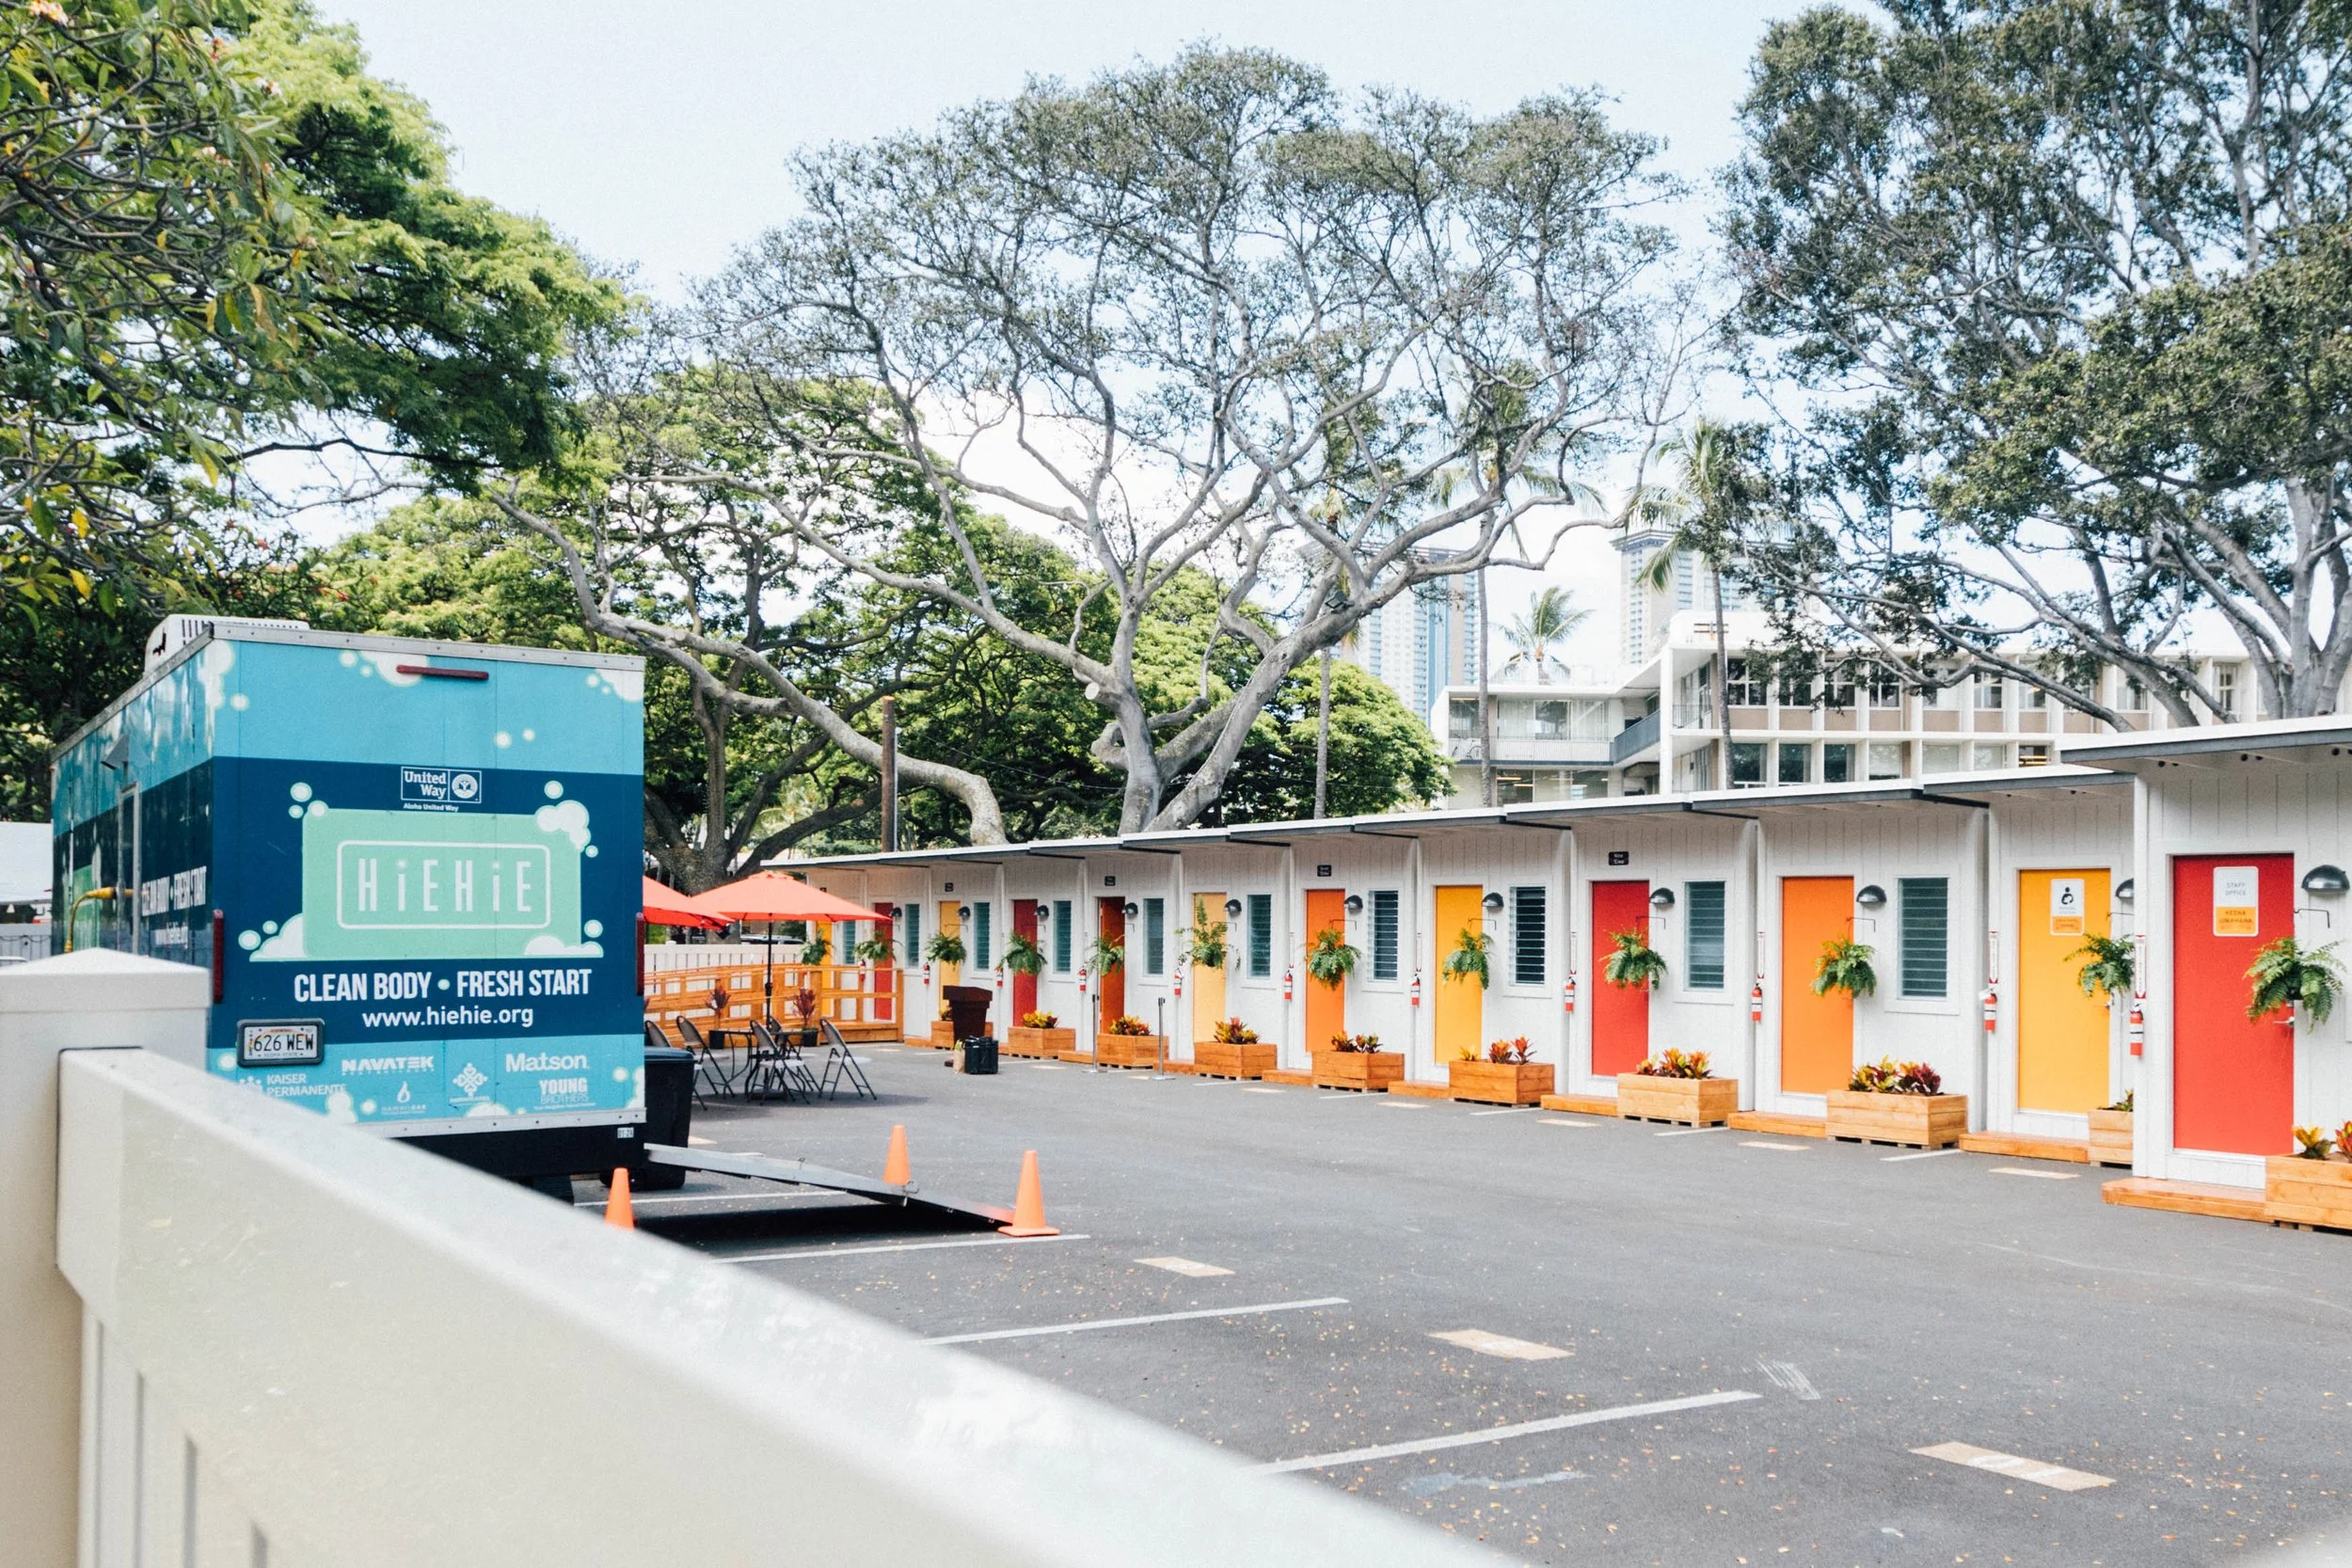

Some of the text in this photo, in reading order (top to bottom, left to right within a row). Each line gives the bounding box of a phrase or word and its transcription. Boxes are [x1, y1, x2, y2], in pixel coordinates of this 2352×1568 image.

[404, 770, 447, 784] United
[420, 784, 447, 800] Way
[358, 858, 532, 912] HiEHiE
[294, 968, 593, 1003] CLEAN BODY FRESH START
[362, 1005, 533, 1028] www.hiehie.org
[253, 1035, 281, 1052] 626
[287, 1033, 313, 1051] WEW
[341, 1055, 435, 1071] NAVATEK
[505, 1052, 588, 1072] Matson
[266, 1073, 307, 1085] KAISER
[539, 1077, 588, 1095] YOUNG
[267, 1084, 346, 1097] PERMANENTE
[540, 1093, 589, 1104] BROTHERS
